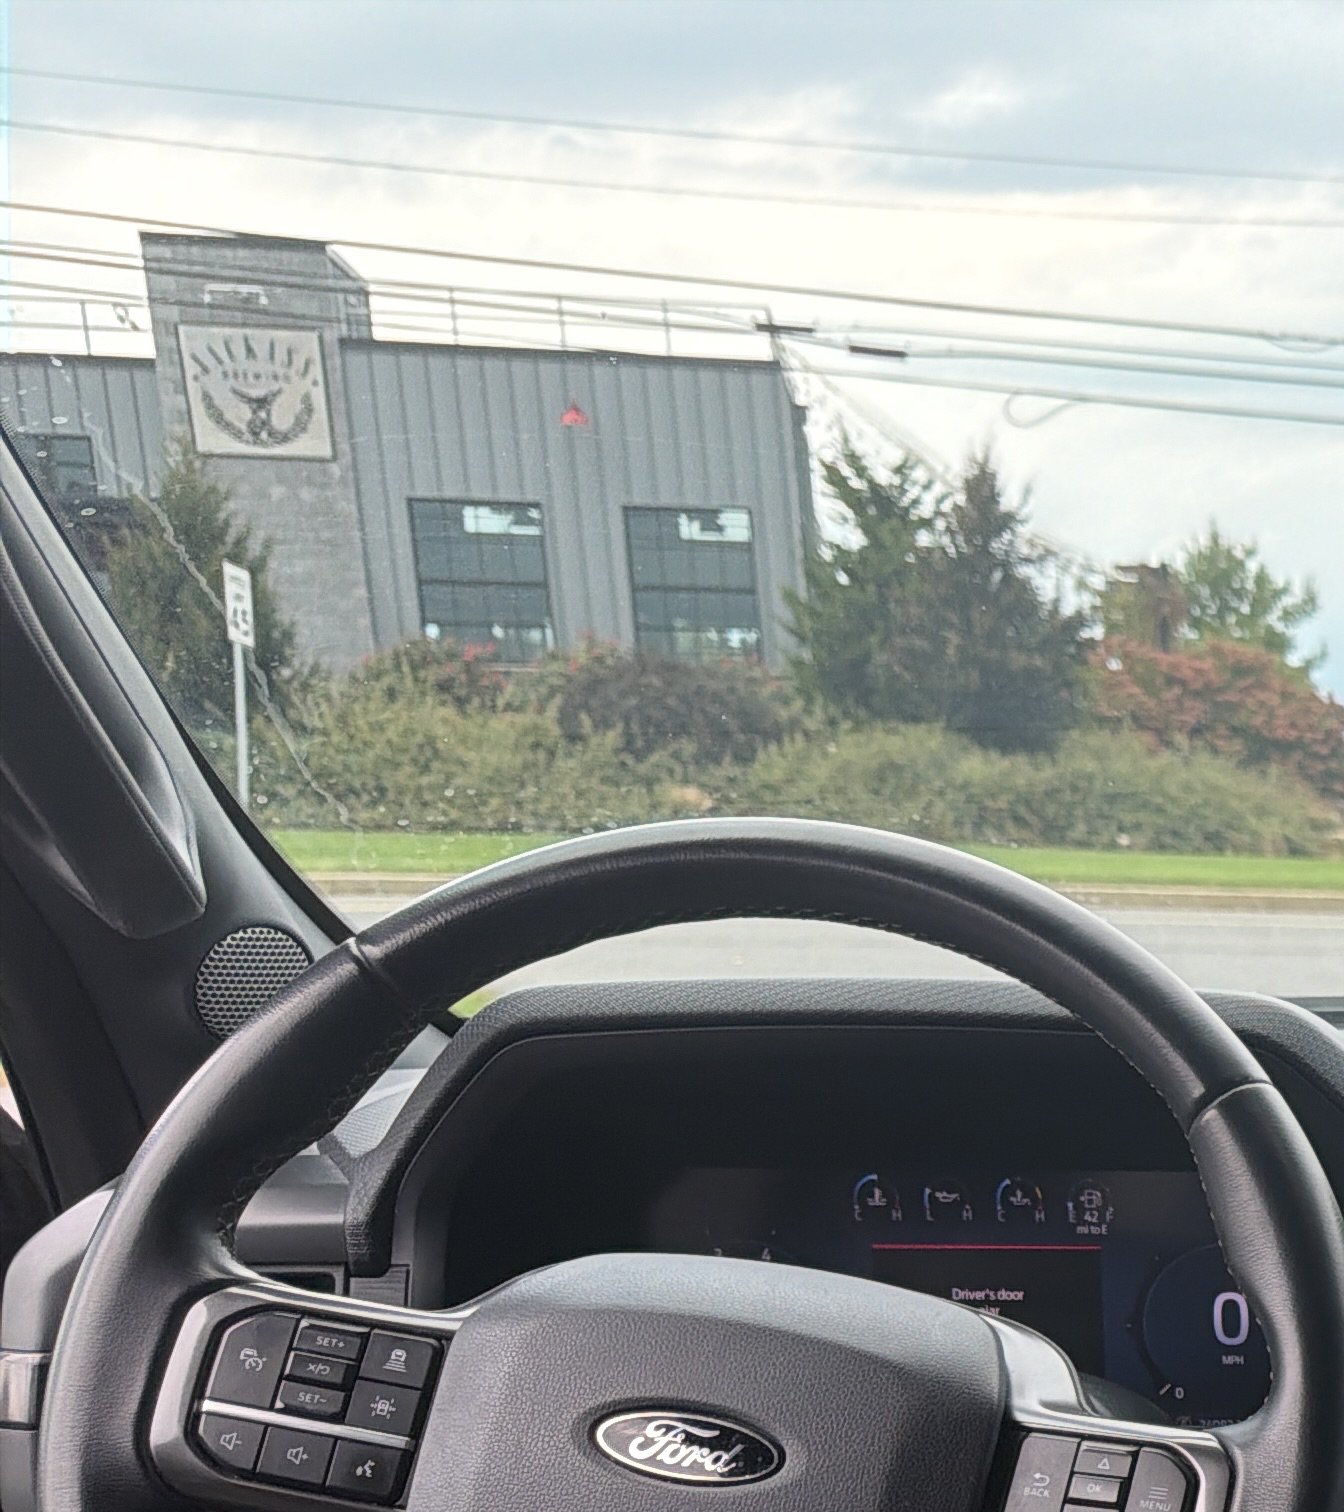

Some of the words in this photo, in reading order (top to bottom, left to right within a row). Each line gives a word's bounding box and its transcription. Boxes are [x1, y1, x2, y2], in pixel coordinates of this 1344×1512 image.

[1083, 1211, 1099, 1222] 42
[952, 1288, 995, 1301] Driver's
[997, 1288, 1025, 1301] door
[1213, 1291, 1250, 1346] 0
[1221, 1355, 1245, 1365] MPH
[628, 1419, 745, 1474] Ford
[1023, 1486, 1051, 1498] BACK
[1086, 1483, 1102, 1493] OK
[1138, 1500, 1172, 1512] MENU
